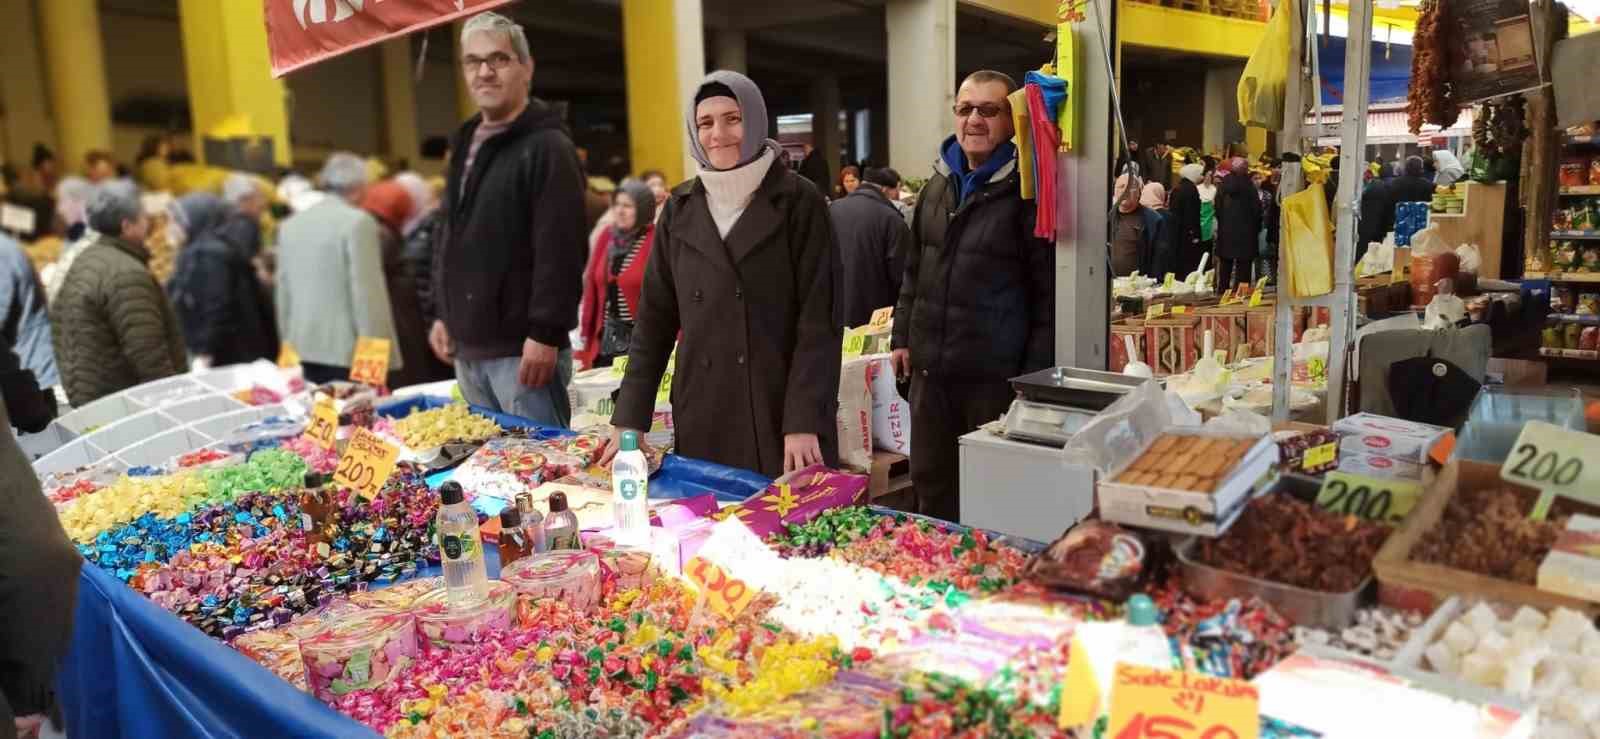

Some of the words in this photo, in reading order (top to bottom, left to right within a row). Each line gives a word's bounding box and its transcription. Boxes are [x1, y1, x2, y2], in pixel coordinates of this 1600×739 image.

[337, 455, 375, 490] 200
[1509, 443, 1584, 486] 200
[1320, 479, 1393, 520] 200
